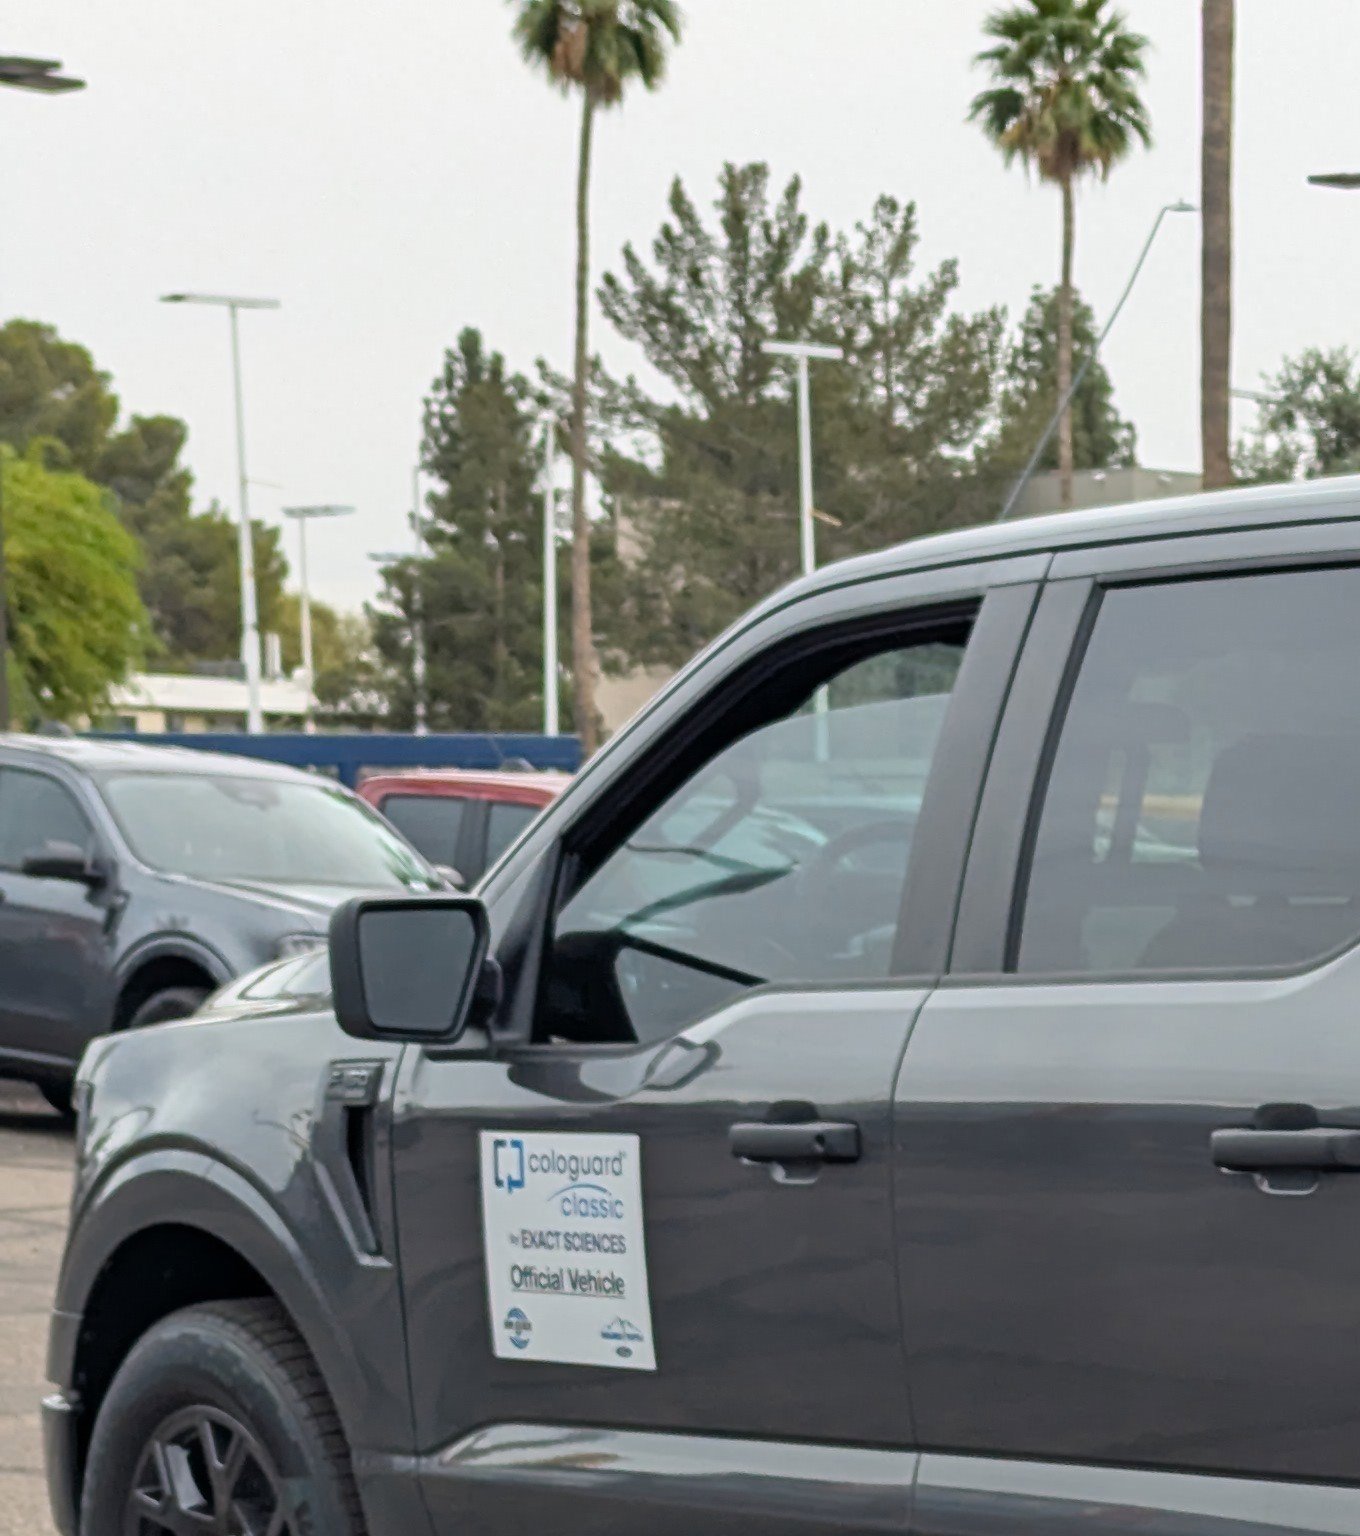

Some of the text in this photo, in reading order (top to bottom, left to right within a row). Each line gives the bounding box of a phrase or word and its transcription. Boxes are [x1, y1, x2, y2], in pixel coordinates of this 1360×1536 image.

[561, 1192, 624, 1219] classic
[521, 1229, 561, 1251] EXACT
[563, 1231, 627, 1254] SCIENCES
[511, 1264, 625, 1296] Official Vehicle
